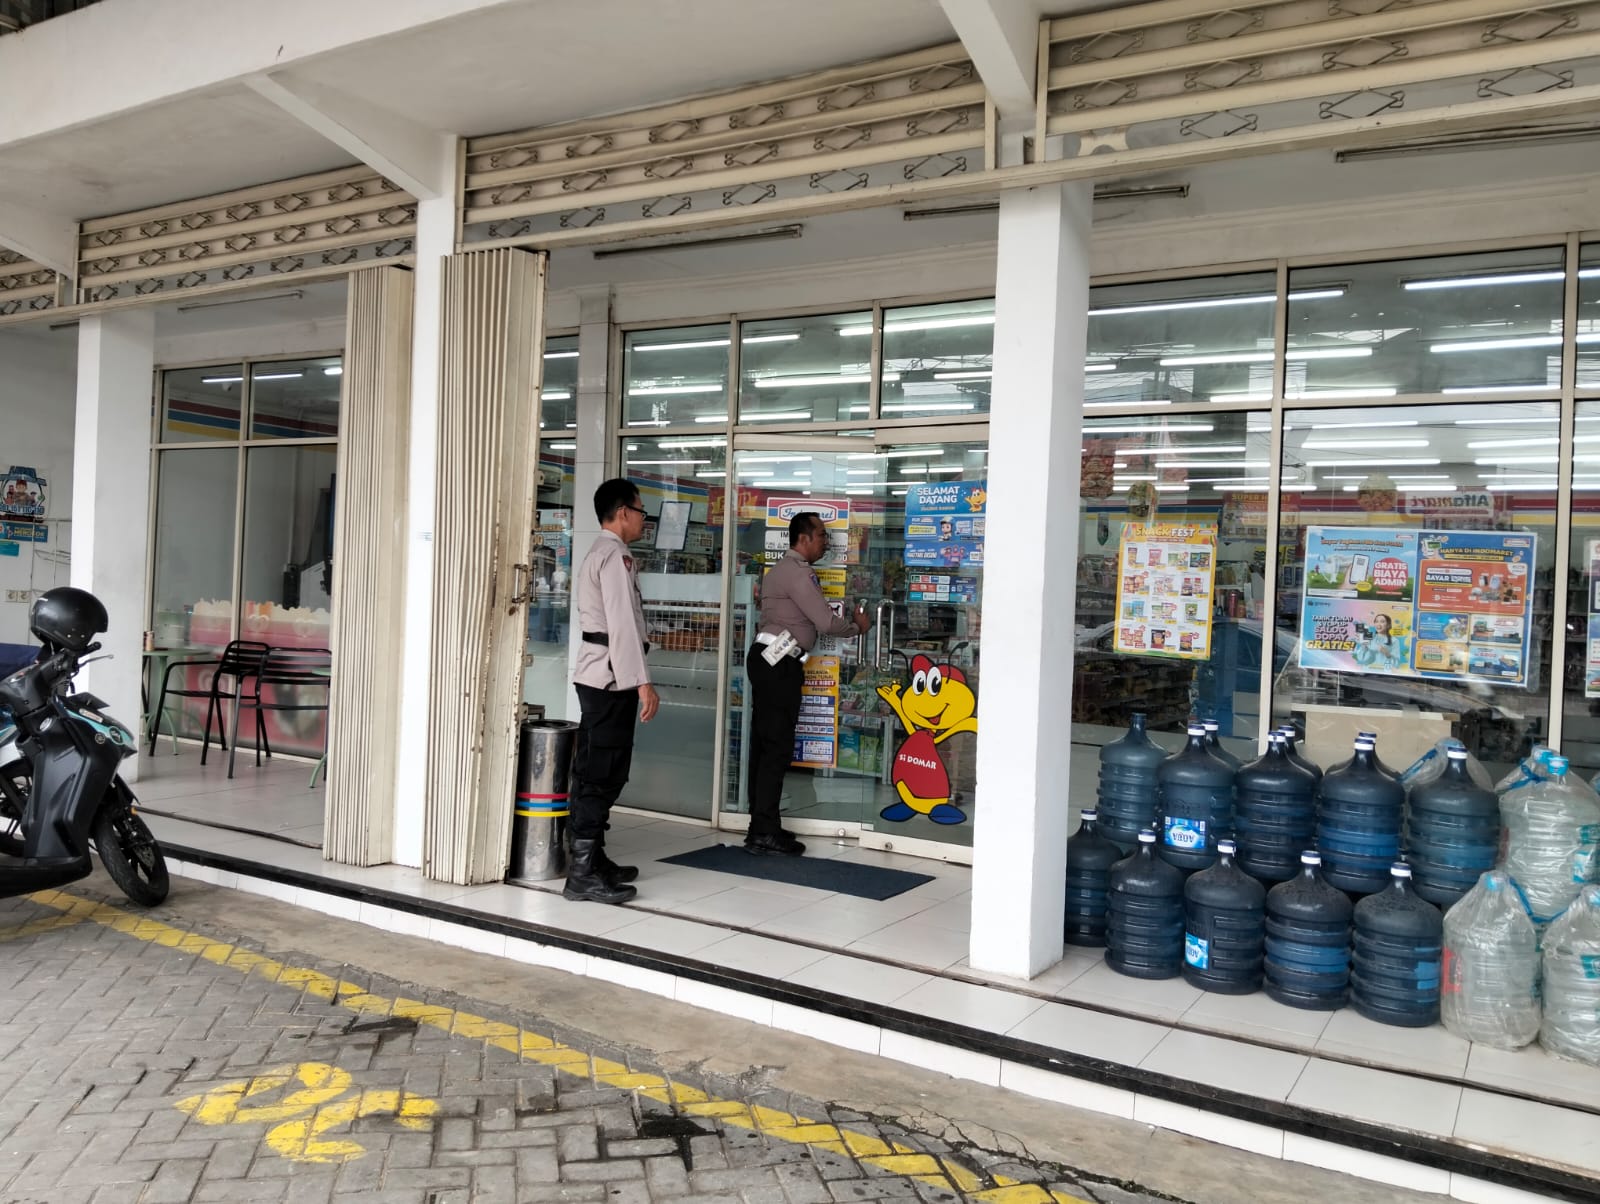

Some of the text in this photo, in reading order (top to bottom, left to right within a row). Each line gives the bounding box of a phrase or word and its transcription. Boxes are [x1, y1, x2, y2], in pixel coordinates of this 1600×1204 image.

[917, 486, 960, 496] SELAMAT
[919, 495, 958, 504] DATANG
[782, 507, 834, 519] Inret
[1136, 527, 1195, 538] SNACK FEST
[765, 552, 784, 560] BUK
[1374, 562, 1407, 570] GRATIS
[1373, 569, 1406, 578] BIAYA
[1425, 574, 1449, 582] BAYAR
[1373, 578, 1407, 587] ADMIN
[1314, 626, 1348, 634] SALDO
[1305, 640, 1356, 651] GRATIS!
[907, 755, 937, 770] DOMAR
